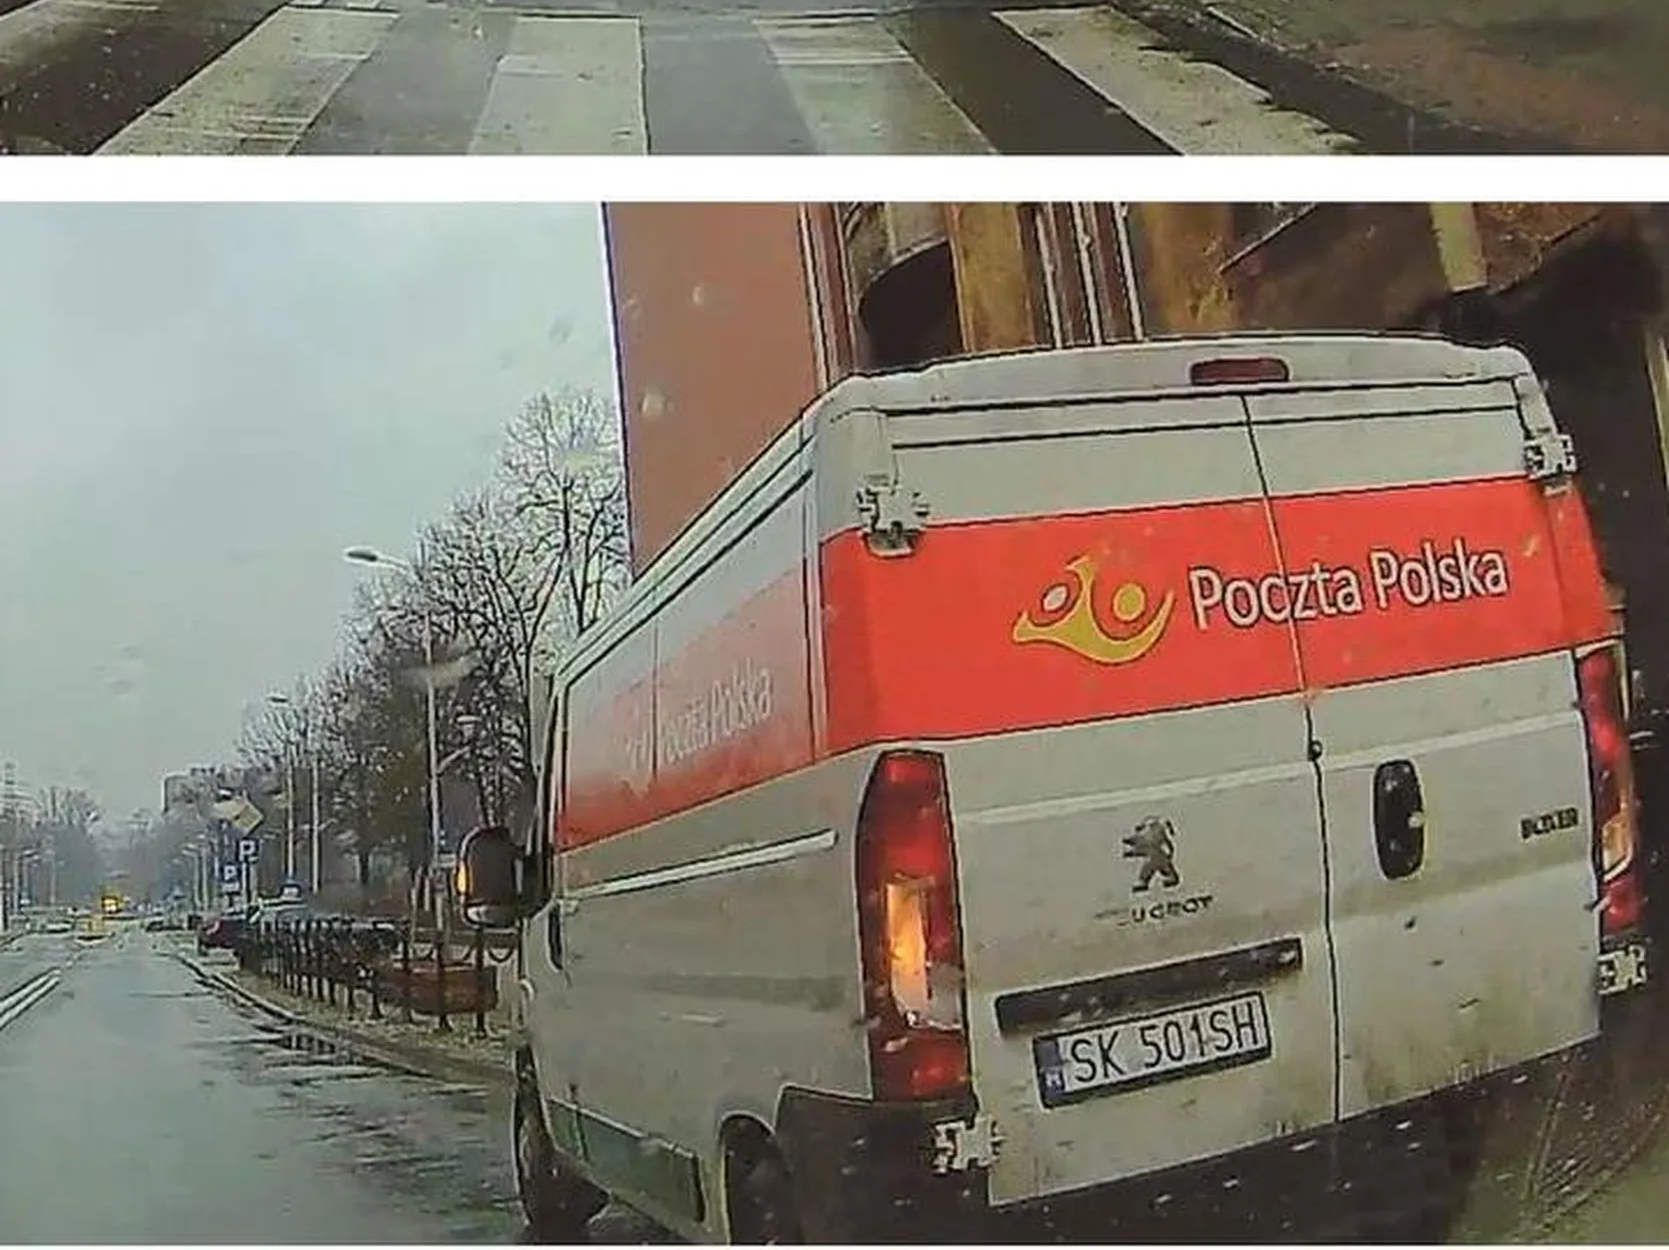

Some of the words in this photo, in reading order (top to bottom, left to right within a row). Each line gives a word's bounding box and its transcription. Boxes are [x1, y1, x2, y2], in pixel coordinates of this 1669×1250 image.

[1189, 561, 1364, 631] Poczta
[1369, 538, 1510, 609] Polska
[239, 839, 256, 862] P
[1070, 1030, 1125, 1084] SK
[1139, 1000, 1258, 1070] 501SH
